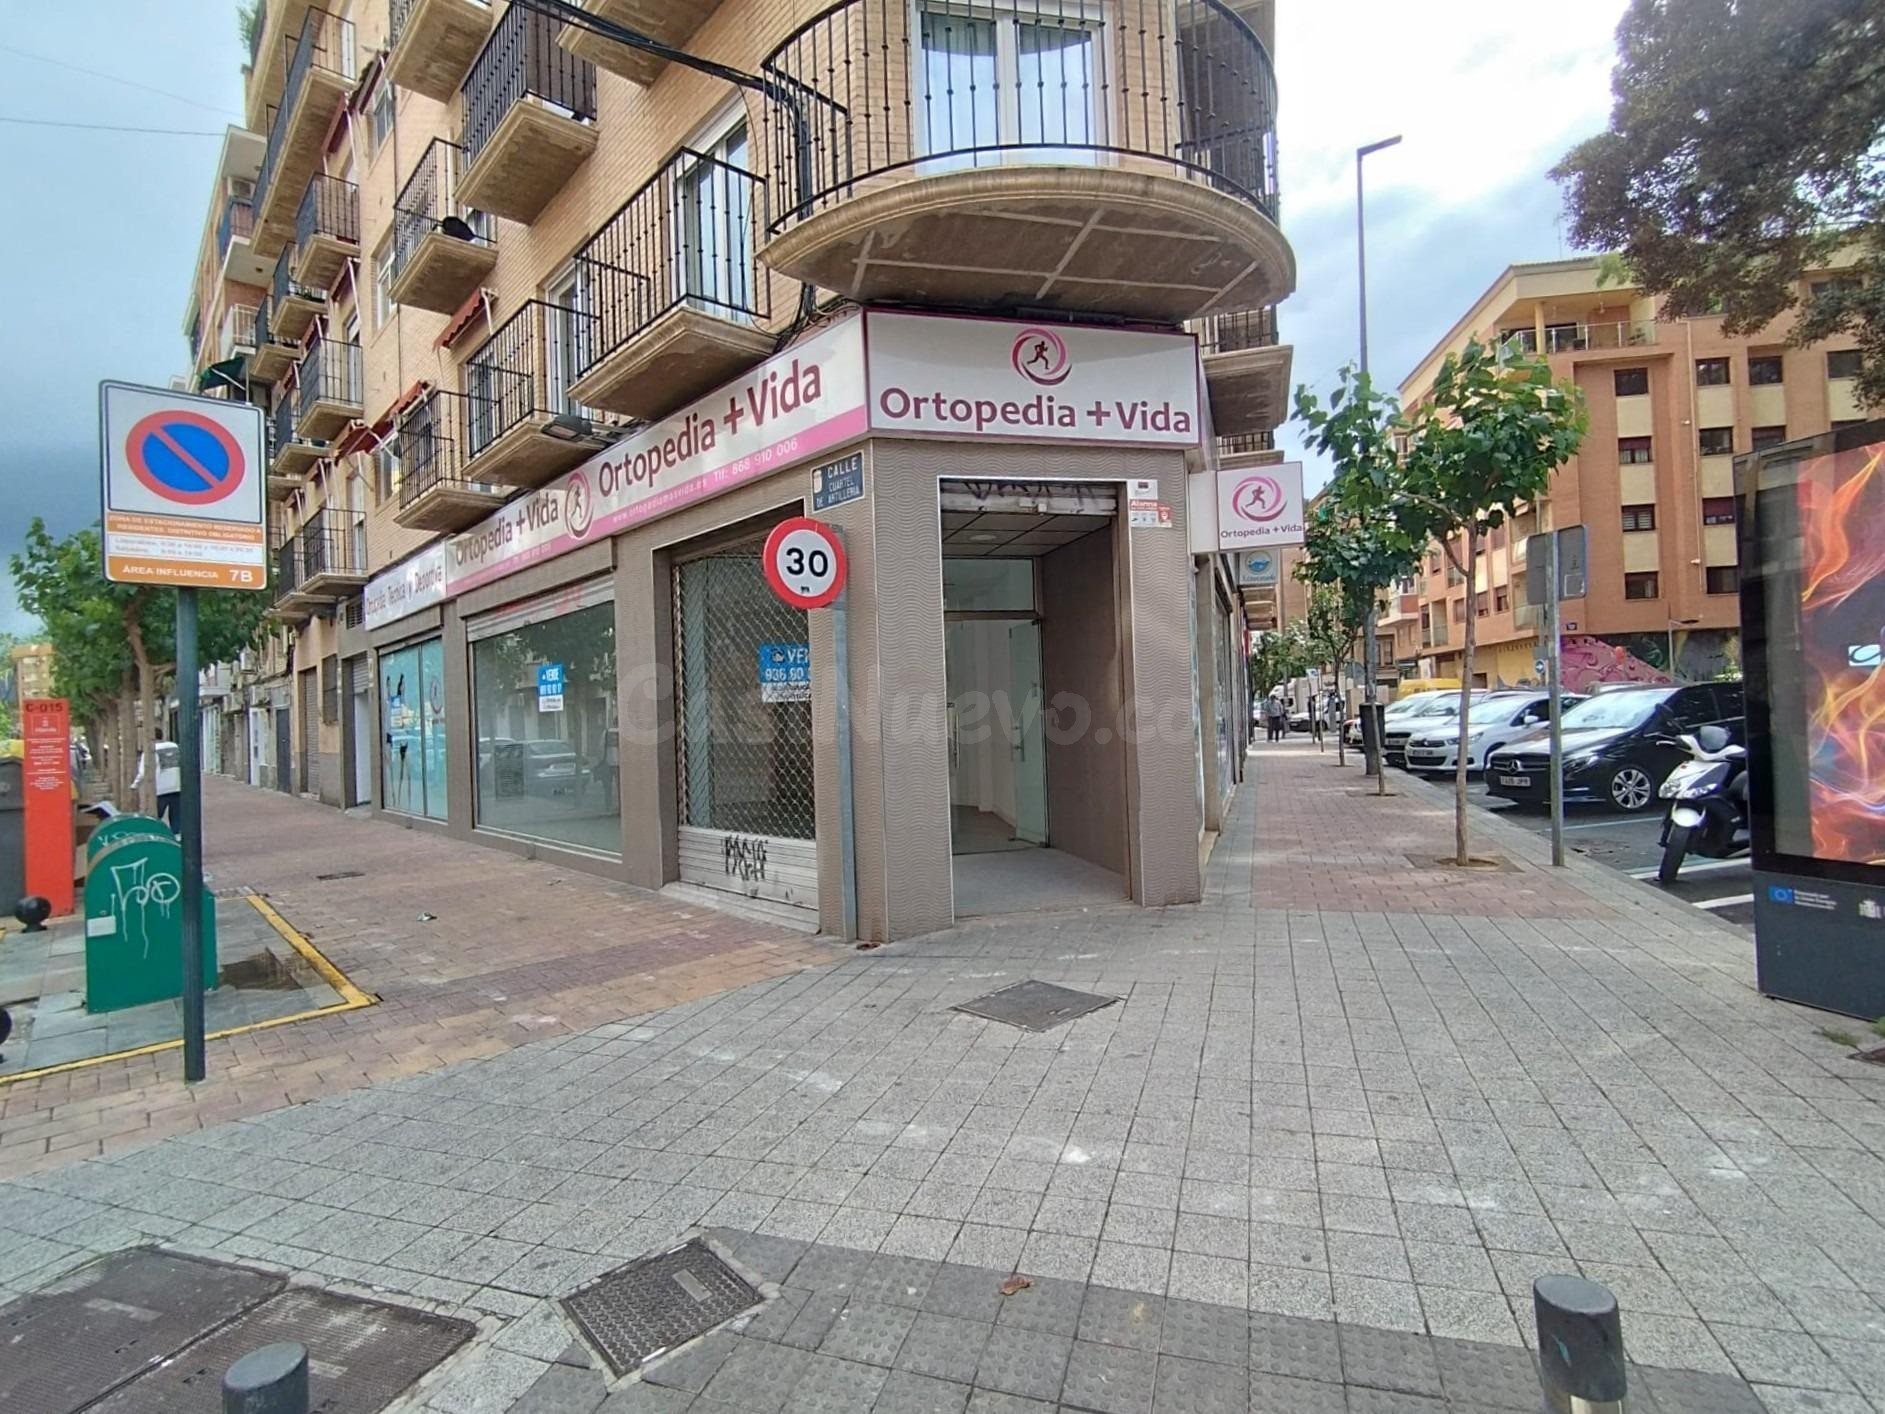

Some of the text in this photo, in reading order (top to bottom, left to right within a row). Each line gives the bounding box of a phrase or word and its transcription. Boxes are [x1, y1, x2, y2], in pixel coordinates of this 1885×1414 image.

[880, 387, 1076, 432] Ortopedia
[599, 412, 716, 497] Ortopedia
[732, 459, 750, 476] 868
[755, 448, 772, 464] 910
[776, 439, 798, 456] 006
[828, 457, 858, 478] CALLE
[456, 517, 512, 567] Ortopedia
[1220, 527, 1271, 538] Ortopedia
[156, 567, 219, 579] INFLUENCIA
[229, 569, 253, 583] 7B
[786, 547, 828, 577] 30
